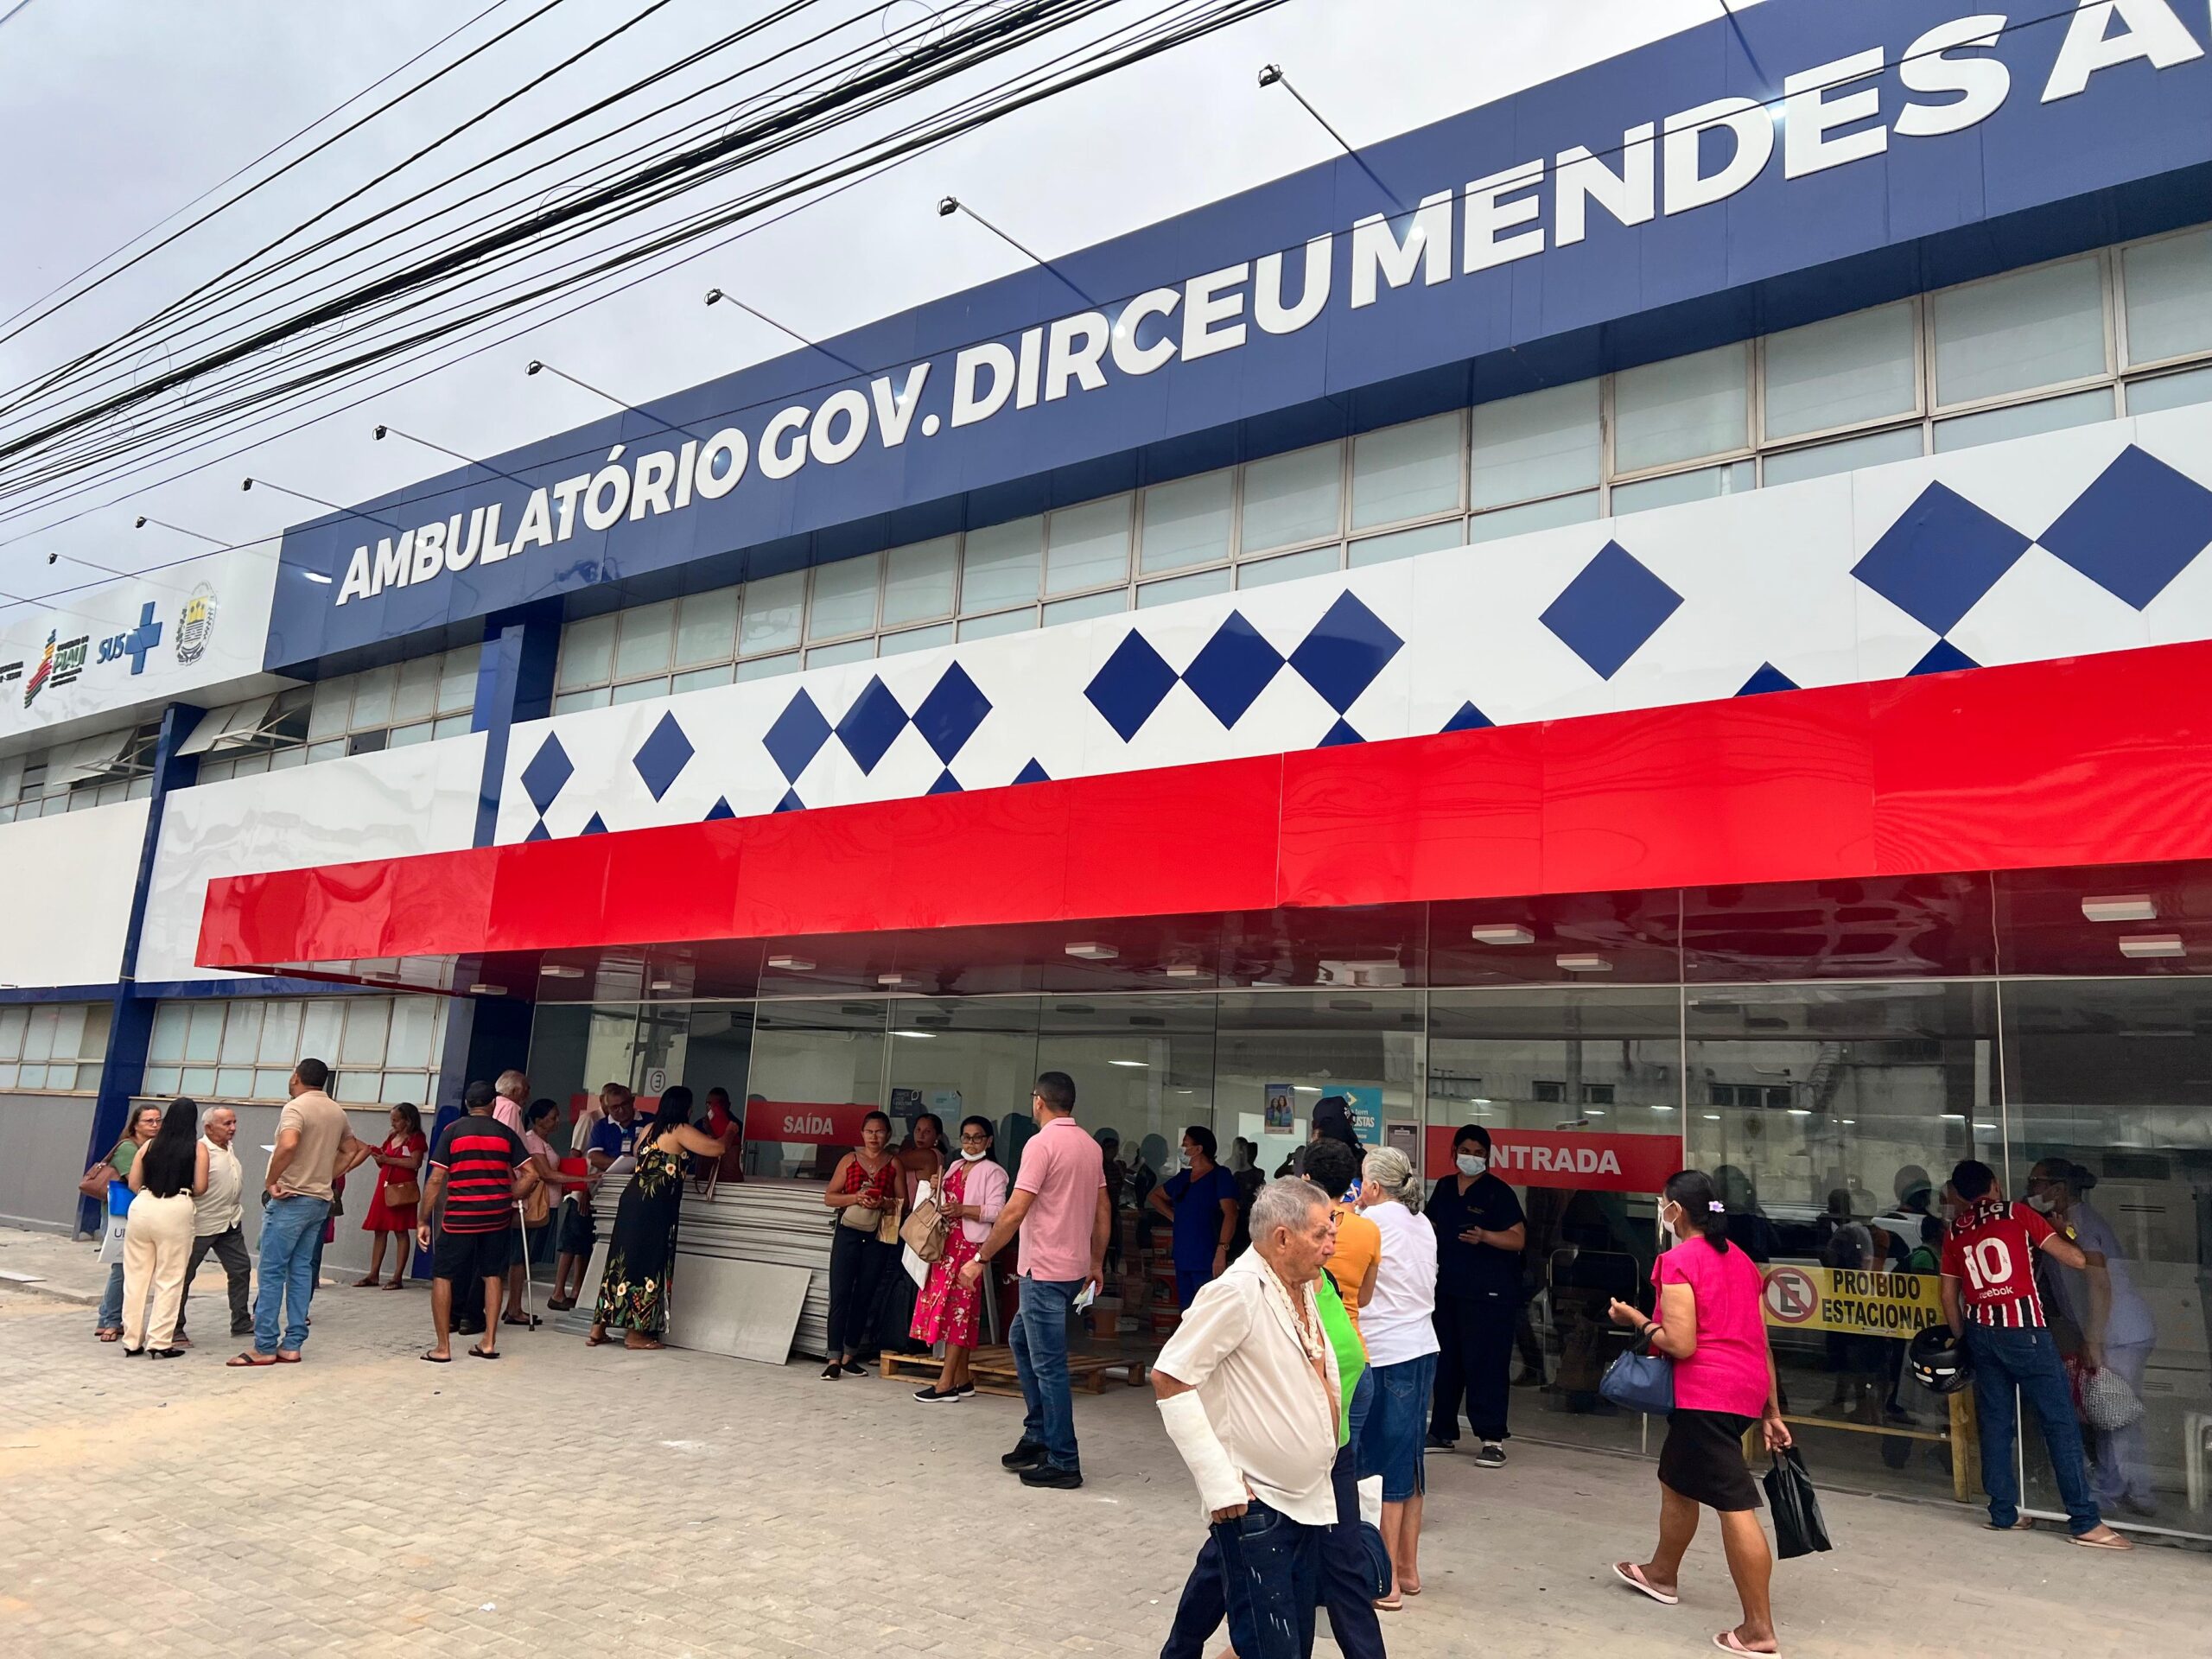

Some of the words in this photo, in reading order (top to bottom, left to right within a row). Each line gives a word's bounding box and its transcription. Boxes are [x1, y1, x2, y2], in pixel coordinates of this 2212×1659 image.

[335, 429, 748, 606] AMBULATÓRIO
[758, 363, 940, 480] GOV.
[951, 232, 1332, 428] DIRCEU
[1351, 14, 2011, 308] MENDES
[2040, 0, 2212, 105] A
[96, 632, 126, 664] SUS
[783, 1112, 834, 1135] SAÍDA
[1489, 1144, 1623, 1175] NTRADA
[1980, 1202, 2004, 1218] LG
[1963, 1237, 2012, 1290] 10
[1833, 1269, 1921, 1300] PROIBIDO
[1821, 1298, 1937, 1331] ESTACIONAR
